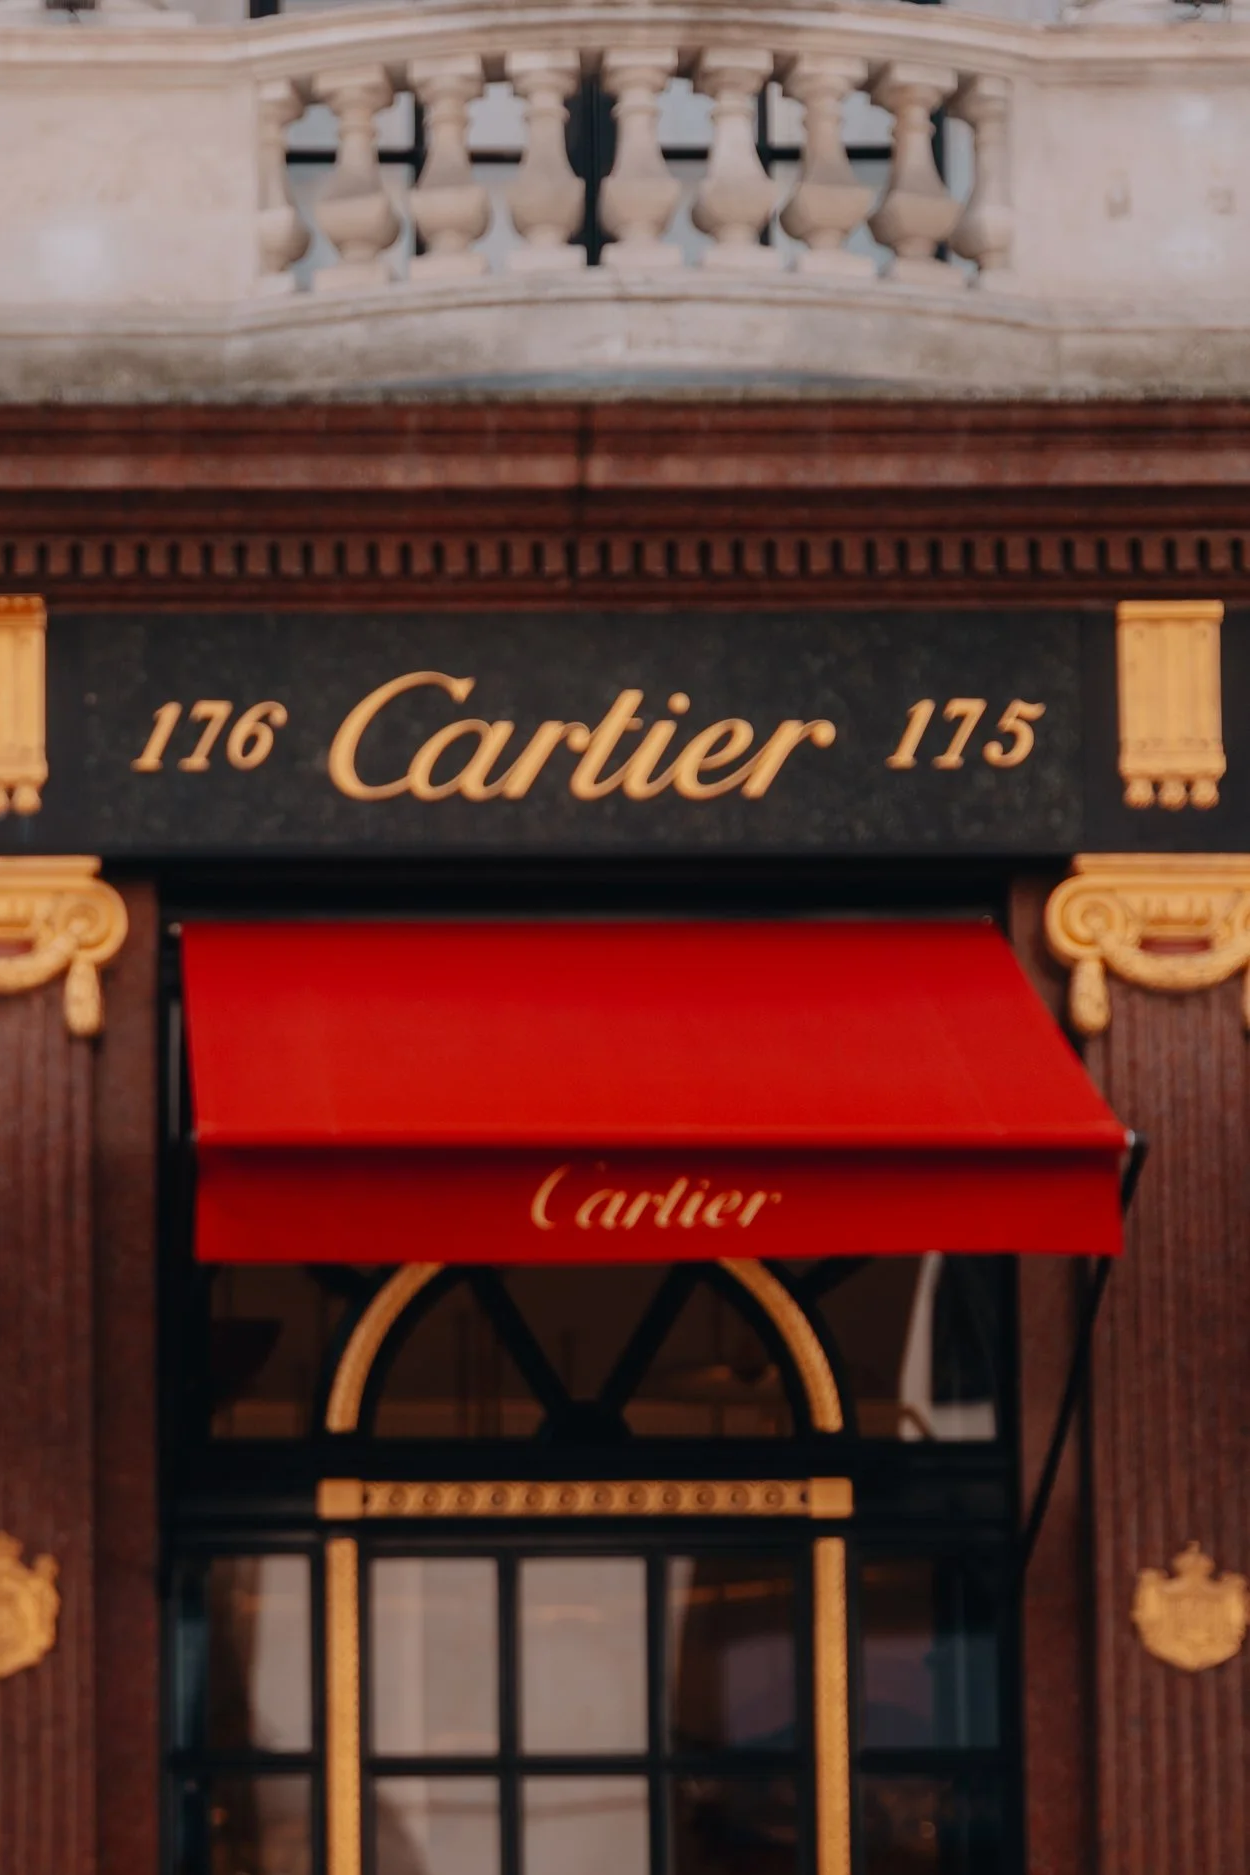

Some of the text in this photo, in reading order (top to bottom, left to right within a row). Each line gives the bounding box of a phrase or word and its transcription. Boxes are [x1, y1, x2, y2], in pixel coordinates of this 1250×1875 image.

[131, 670, 1046, 800] 176 Cartier 175
[531, 1161, 782, 1230] Cartier
